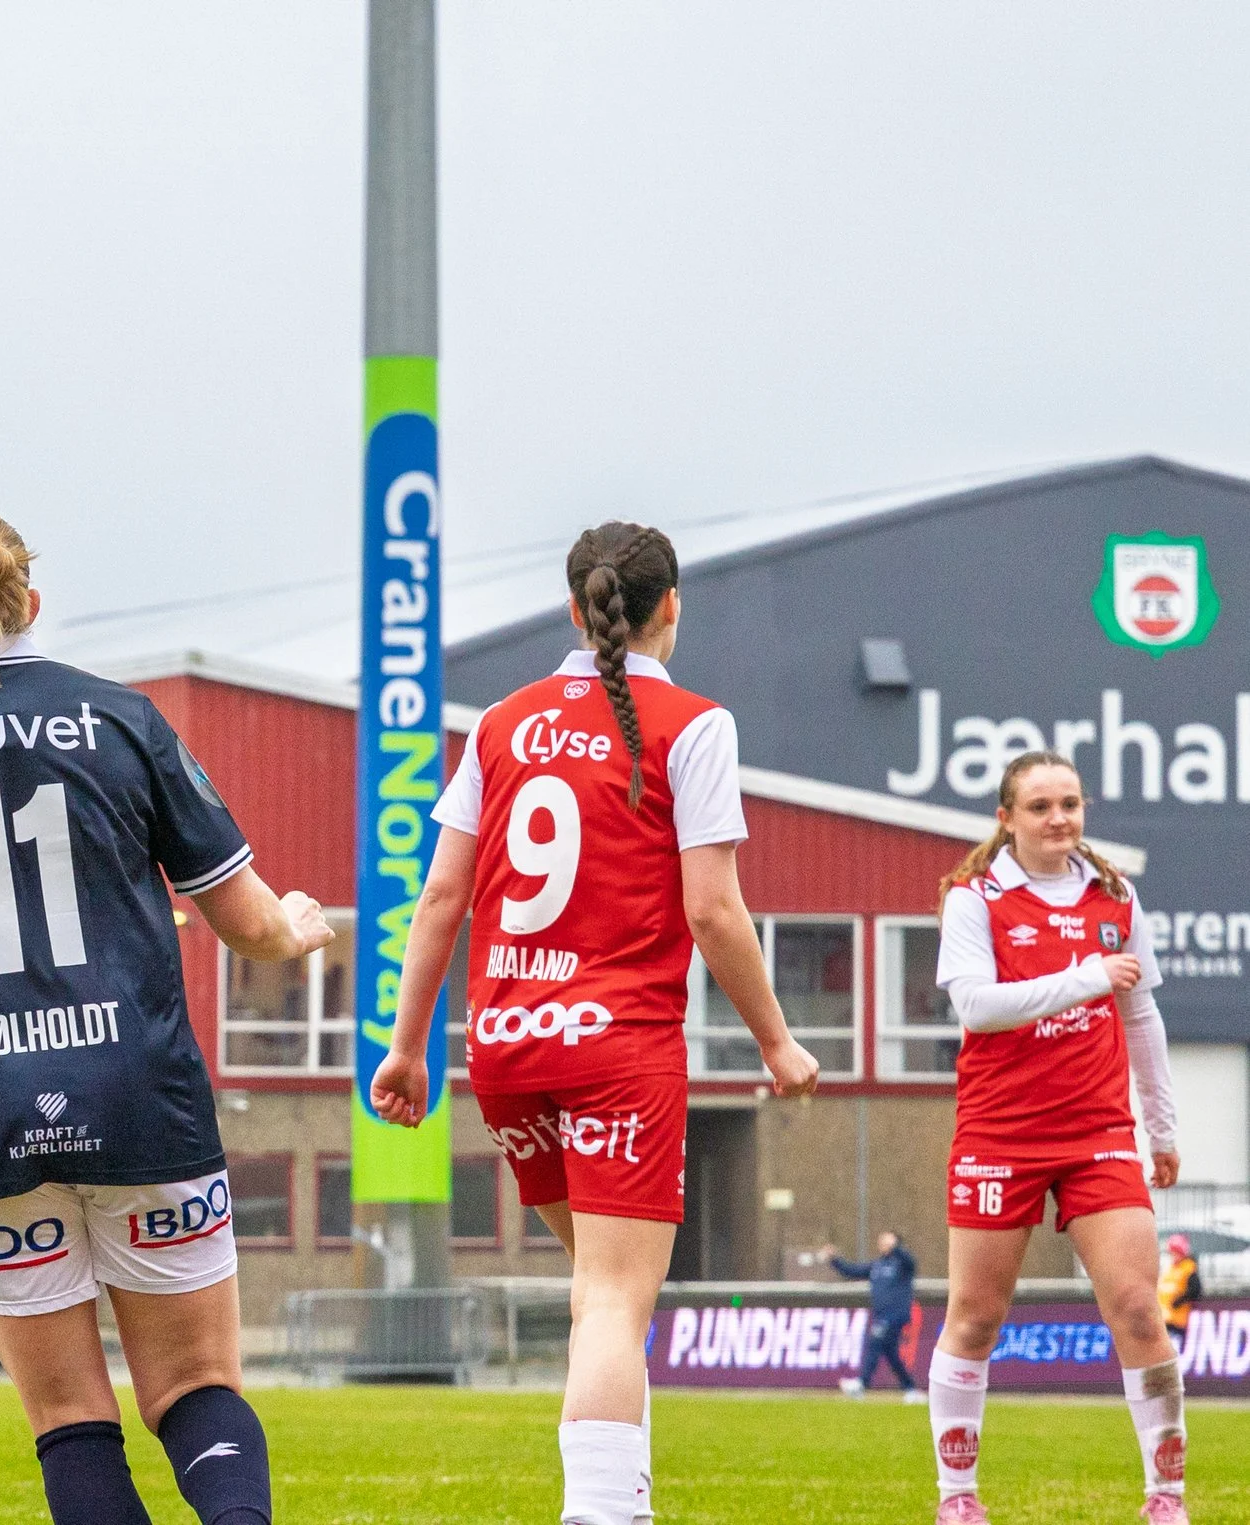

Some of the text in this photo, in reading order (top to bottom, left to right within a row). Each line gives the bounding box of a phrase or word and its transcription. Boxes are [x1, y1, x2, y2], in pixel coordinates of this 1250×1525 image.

[529, 722, 611, 764] Lyse
[500, 775, 581, 935] 9
[486, 945, 578, 982] HAALAND
[476, 1001, 613, 1046] coop
[9, 1138, 102, 1159] KJÆRLIGHET
[24, 1126, 74, 1143] KRAFT
[146, 1178, 228, 1239] BDO
[977, 1181, 1003, 1216] 16
[667, 1307, 869, 1369] P.UNDHEIM
